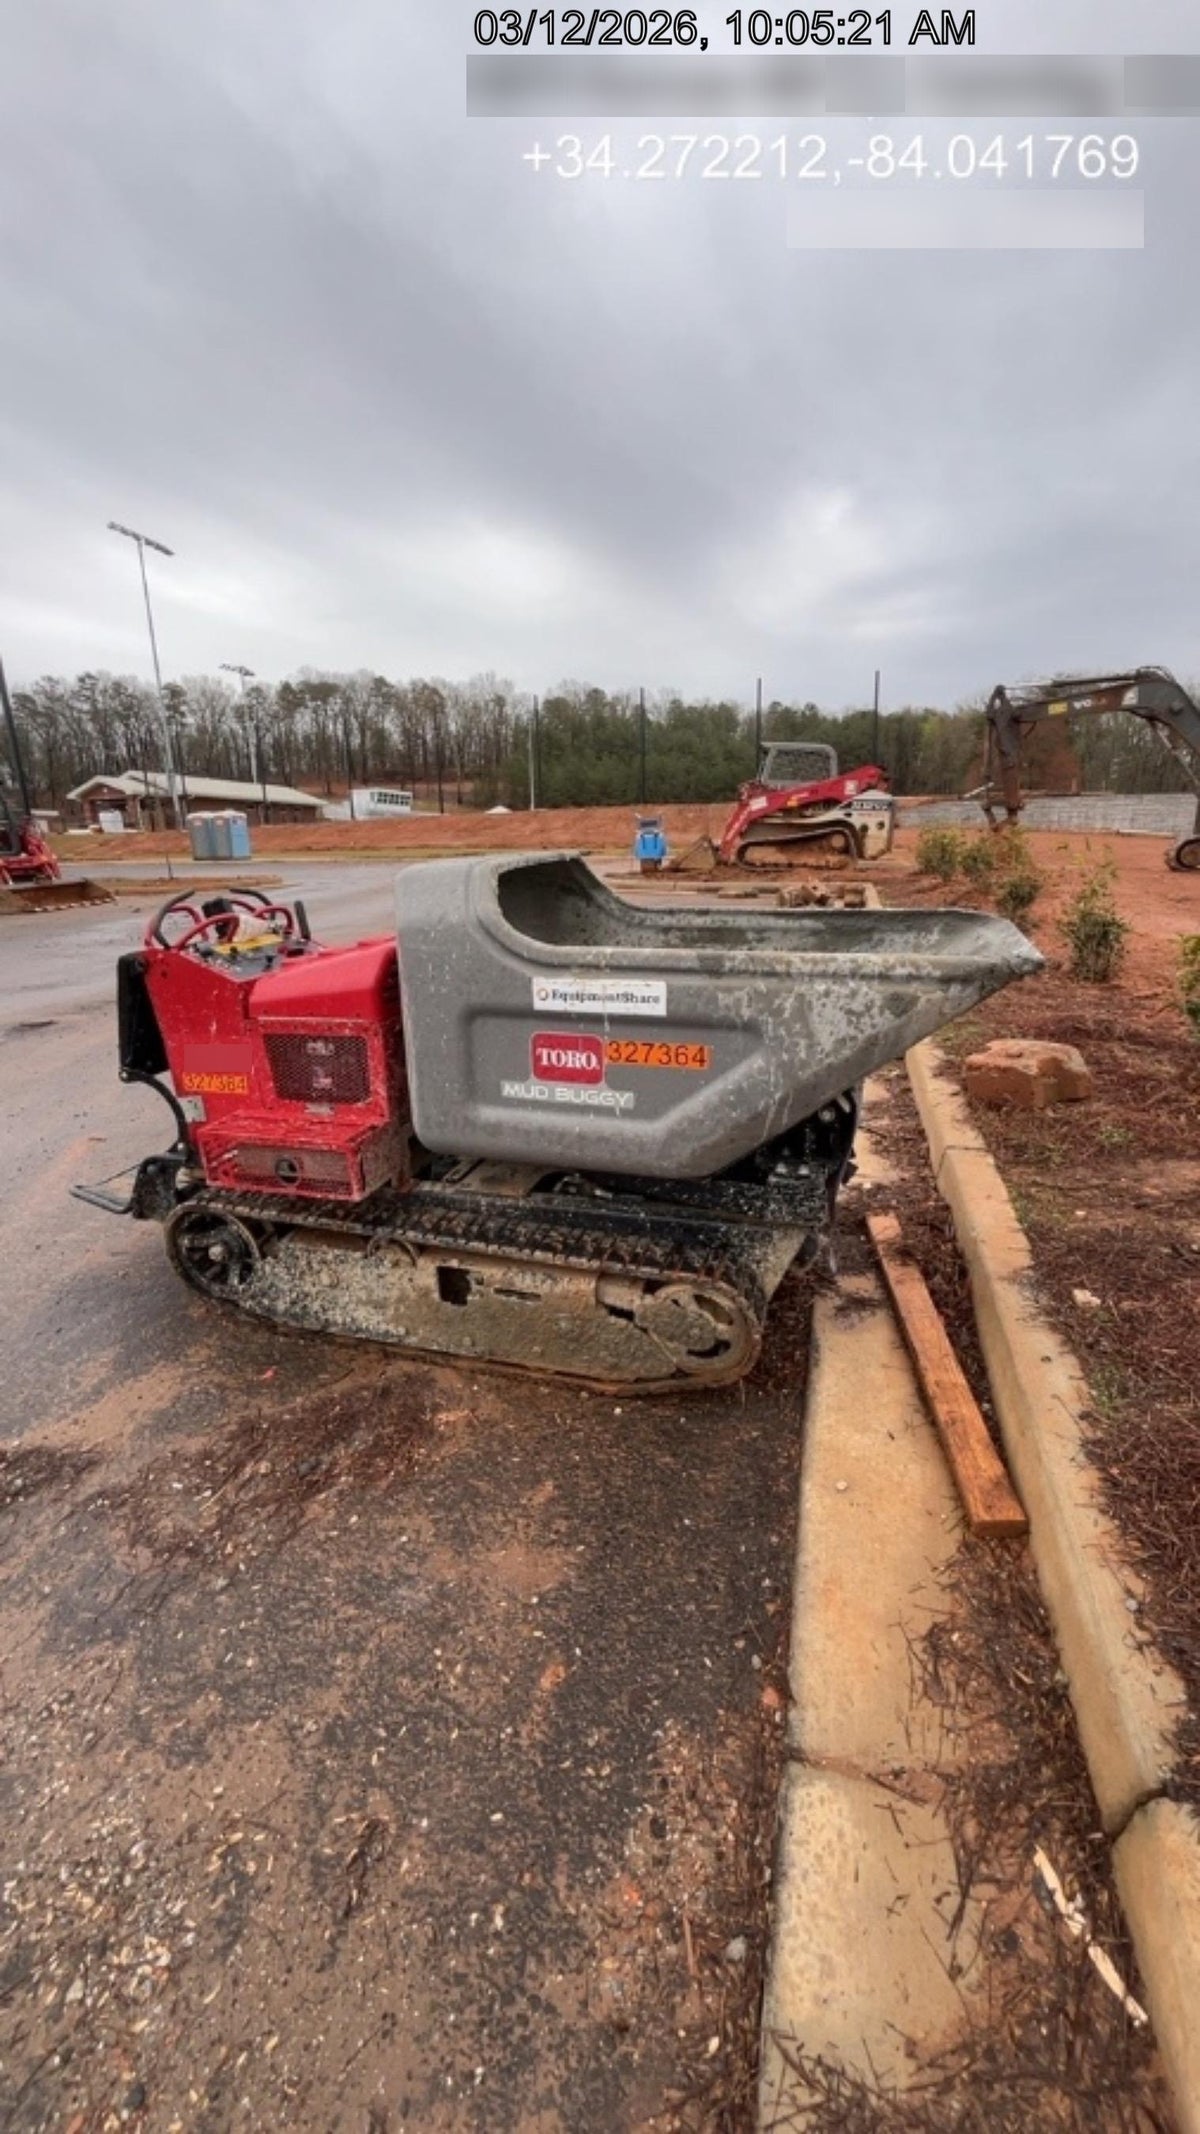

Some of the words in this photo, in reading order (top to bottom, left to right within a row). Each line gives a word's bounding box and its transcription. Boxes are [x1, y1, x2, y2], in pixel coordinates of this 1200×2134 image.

[535, 1048, 598, 1070] TORO
[608, 1041, 707, 1067] 327364
[503, 1084, 549, 1100] MUD
[555, 1088, 630, 1106] BUGGY
